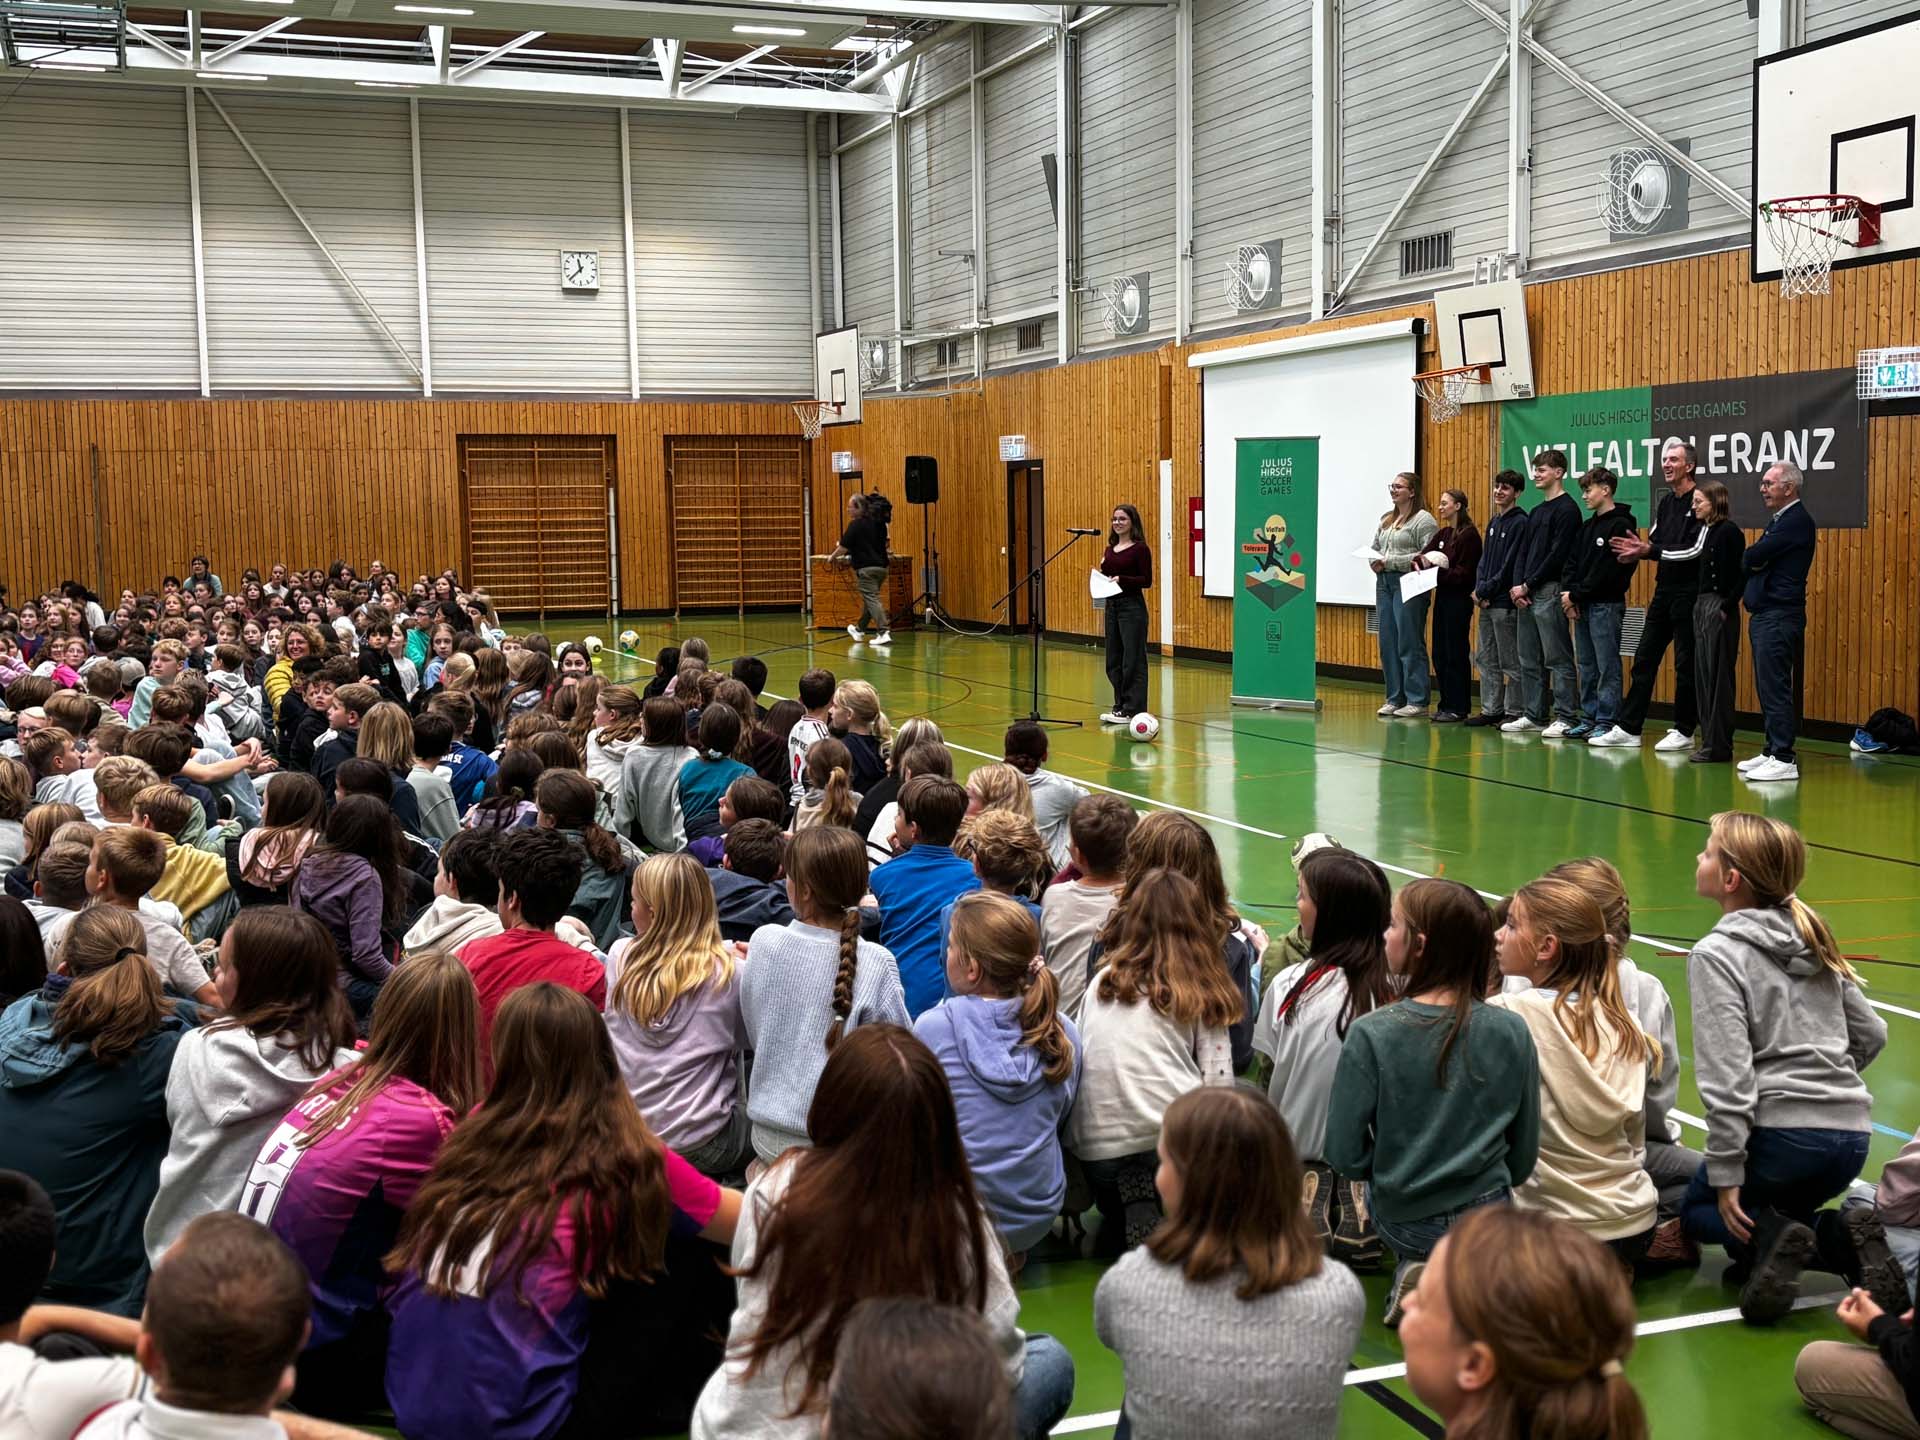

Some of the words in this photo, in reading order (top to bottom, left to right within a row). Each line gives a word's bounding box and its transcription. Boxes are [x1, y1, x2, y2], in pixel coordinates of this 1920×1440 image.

[1570, 412, 1606, 427] JULIUS
[1609, 408, 1649, 425] HIRSCH
[1654, 404, 1701, 422] SOCCER
[1703, 400, 1747, 418] GAMES
[1260, 457, 1293, 468] JULIUS
[1260, 467, 1292, 477] HIRSCH
[1260, 476, 1292, 486] SOCCER
[1260, 486, 1292, 496] GAMES
